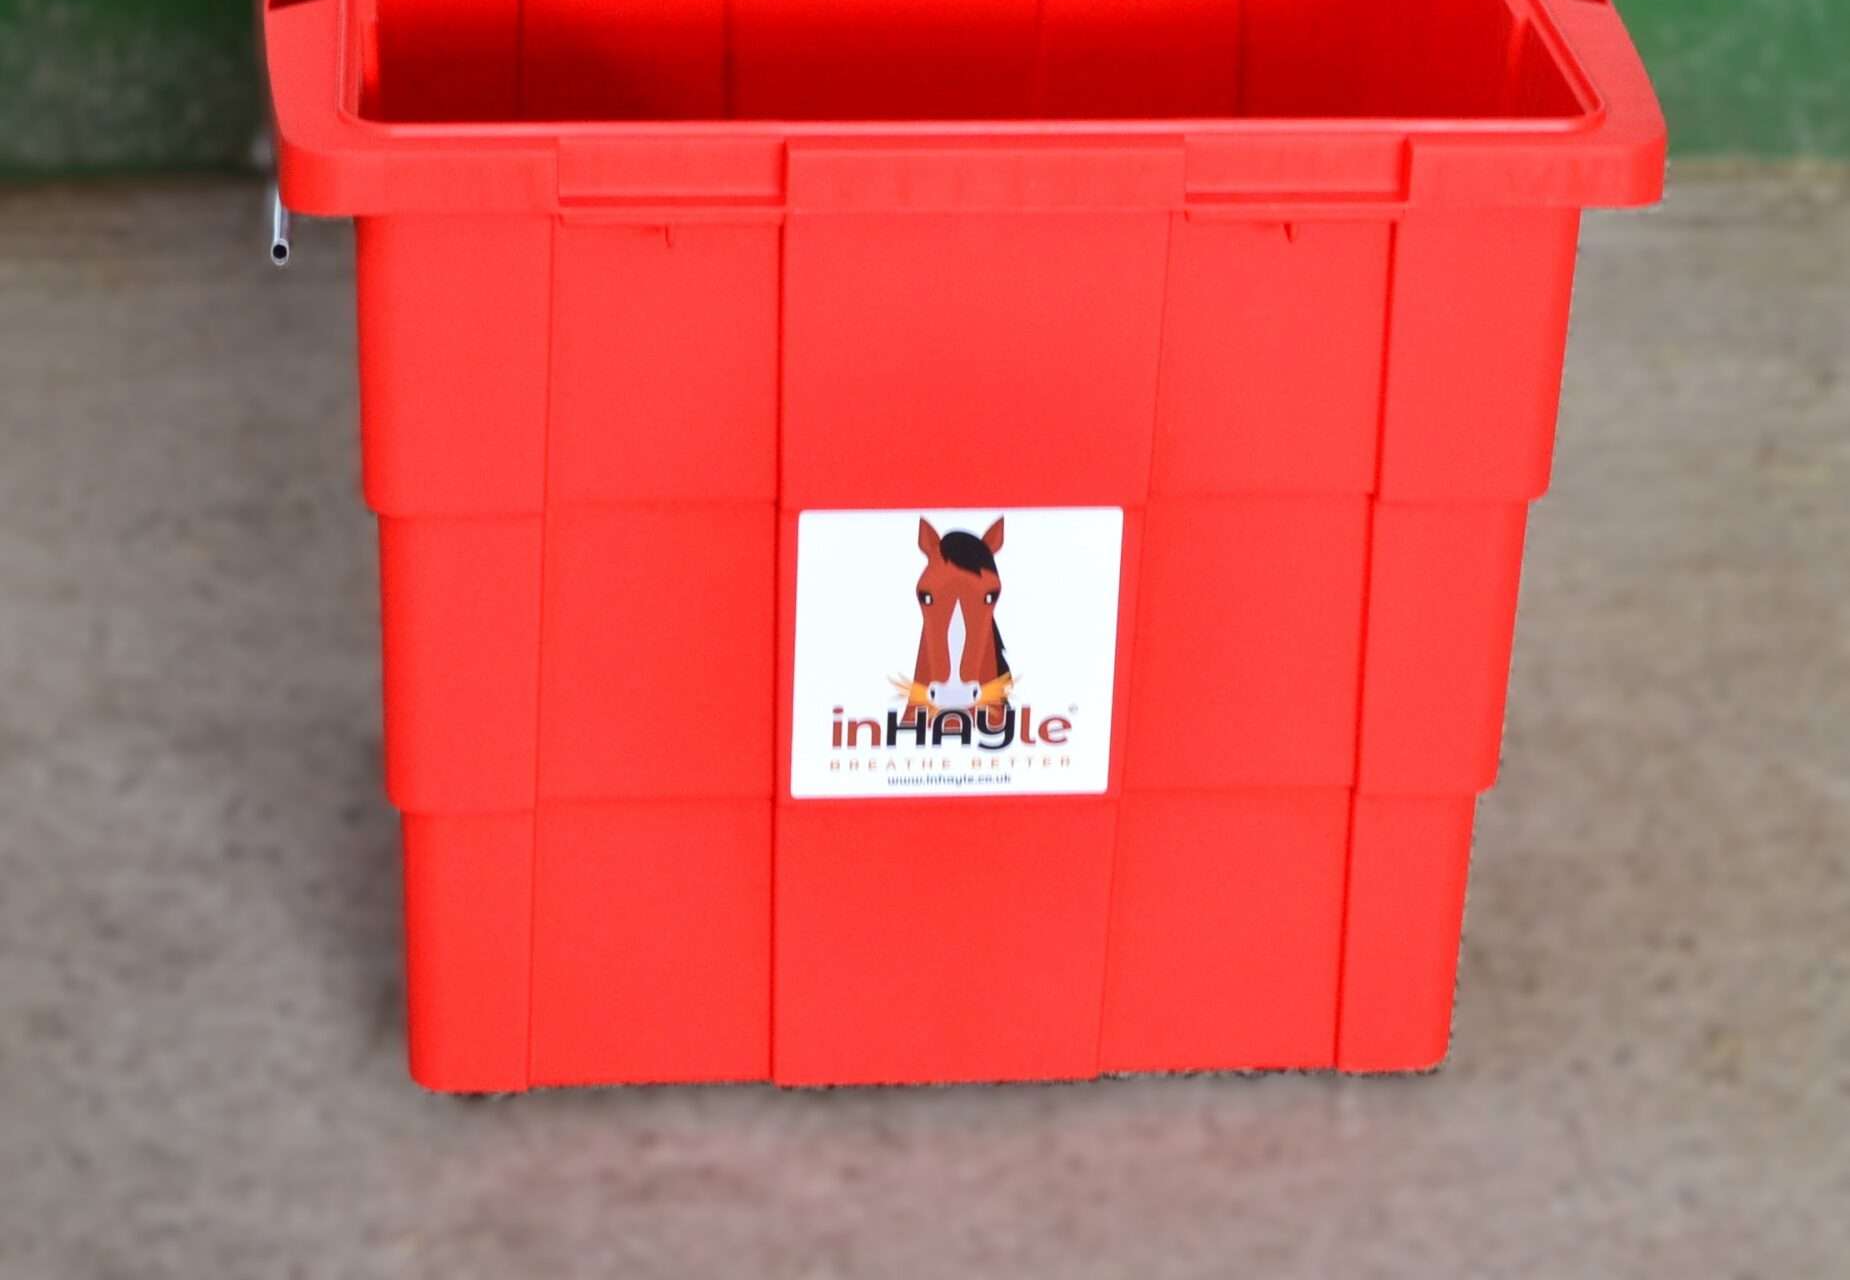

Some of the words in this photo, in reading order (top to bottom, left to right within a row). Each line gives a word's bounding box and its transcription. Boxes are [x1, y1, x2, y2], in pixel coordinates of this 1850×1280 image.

[829, 758, 953, 773] BREATHE
[971, 754, 1072, 769] BETTER
[887, 773, 1012, 788] www.inhayle.co.uk
